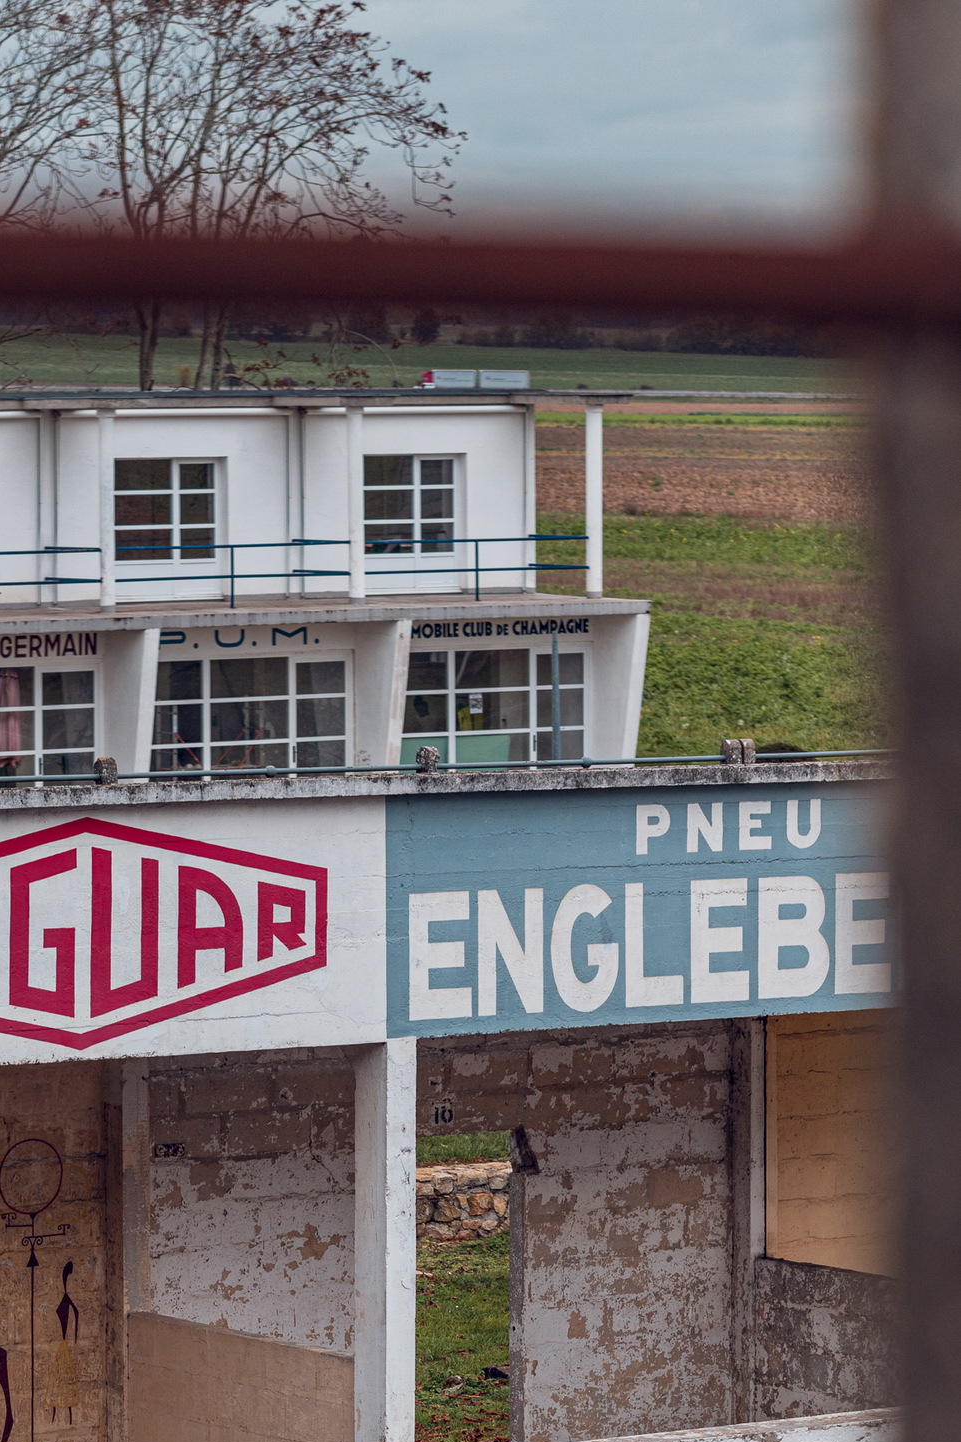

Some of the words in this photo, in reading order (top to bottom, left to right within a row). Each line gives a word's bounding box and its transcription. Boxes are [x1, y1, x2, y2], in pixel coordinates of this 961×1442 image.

[0, 632, 98, 659] GERMAIN
[410, 622, 459, 639] MOBILE
[462, 621, 493, 637] CLUB
[496, 623, 509, 636] DE
[512, 617, 589, 636] CHAMPAGNE
[636, 798, 822, 855] PNEU
[409, 871, 894, 1021] ENGLEBE
